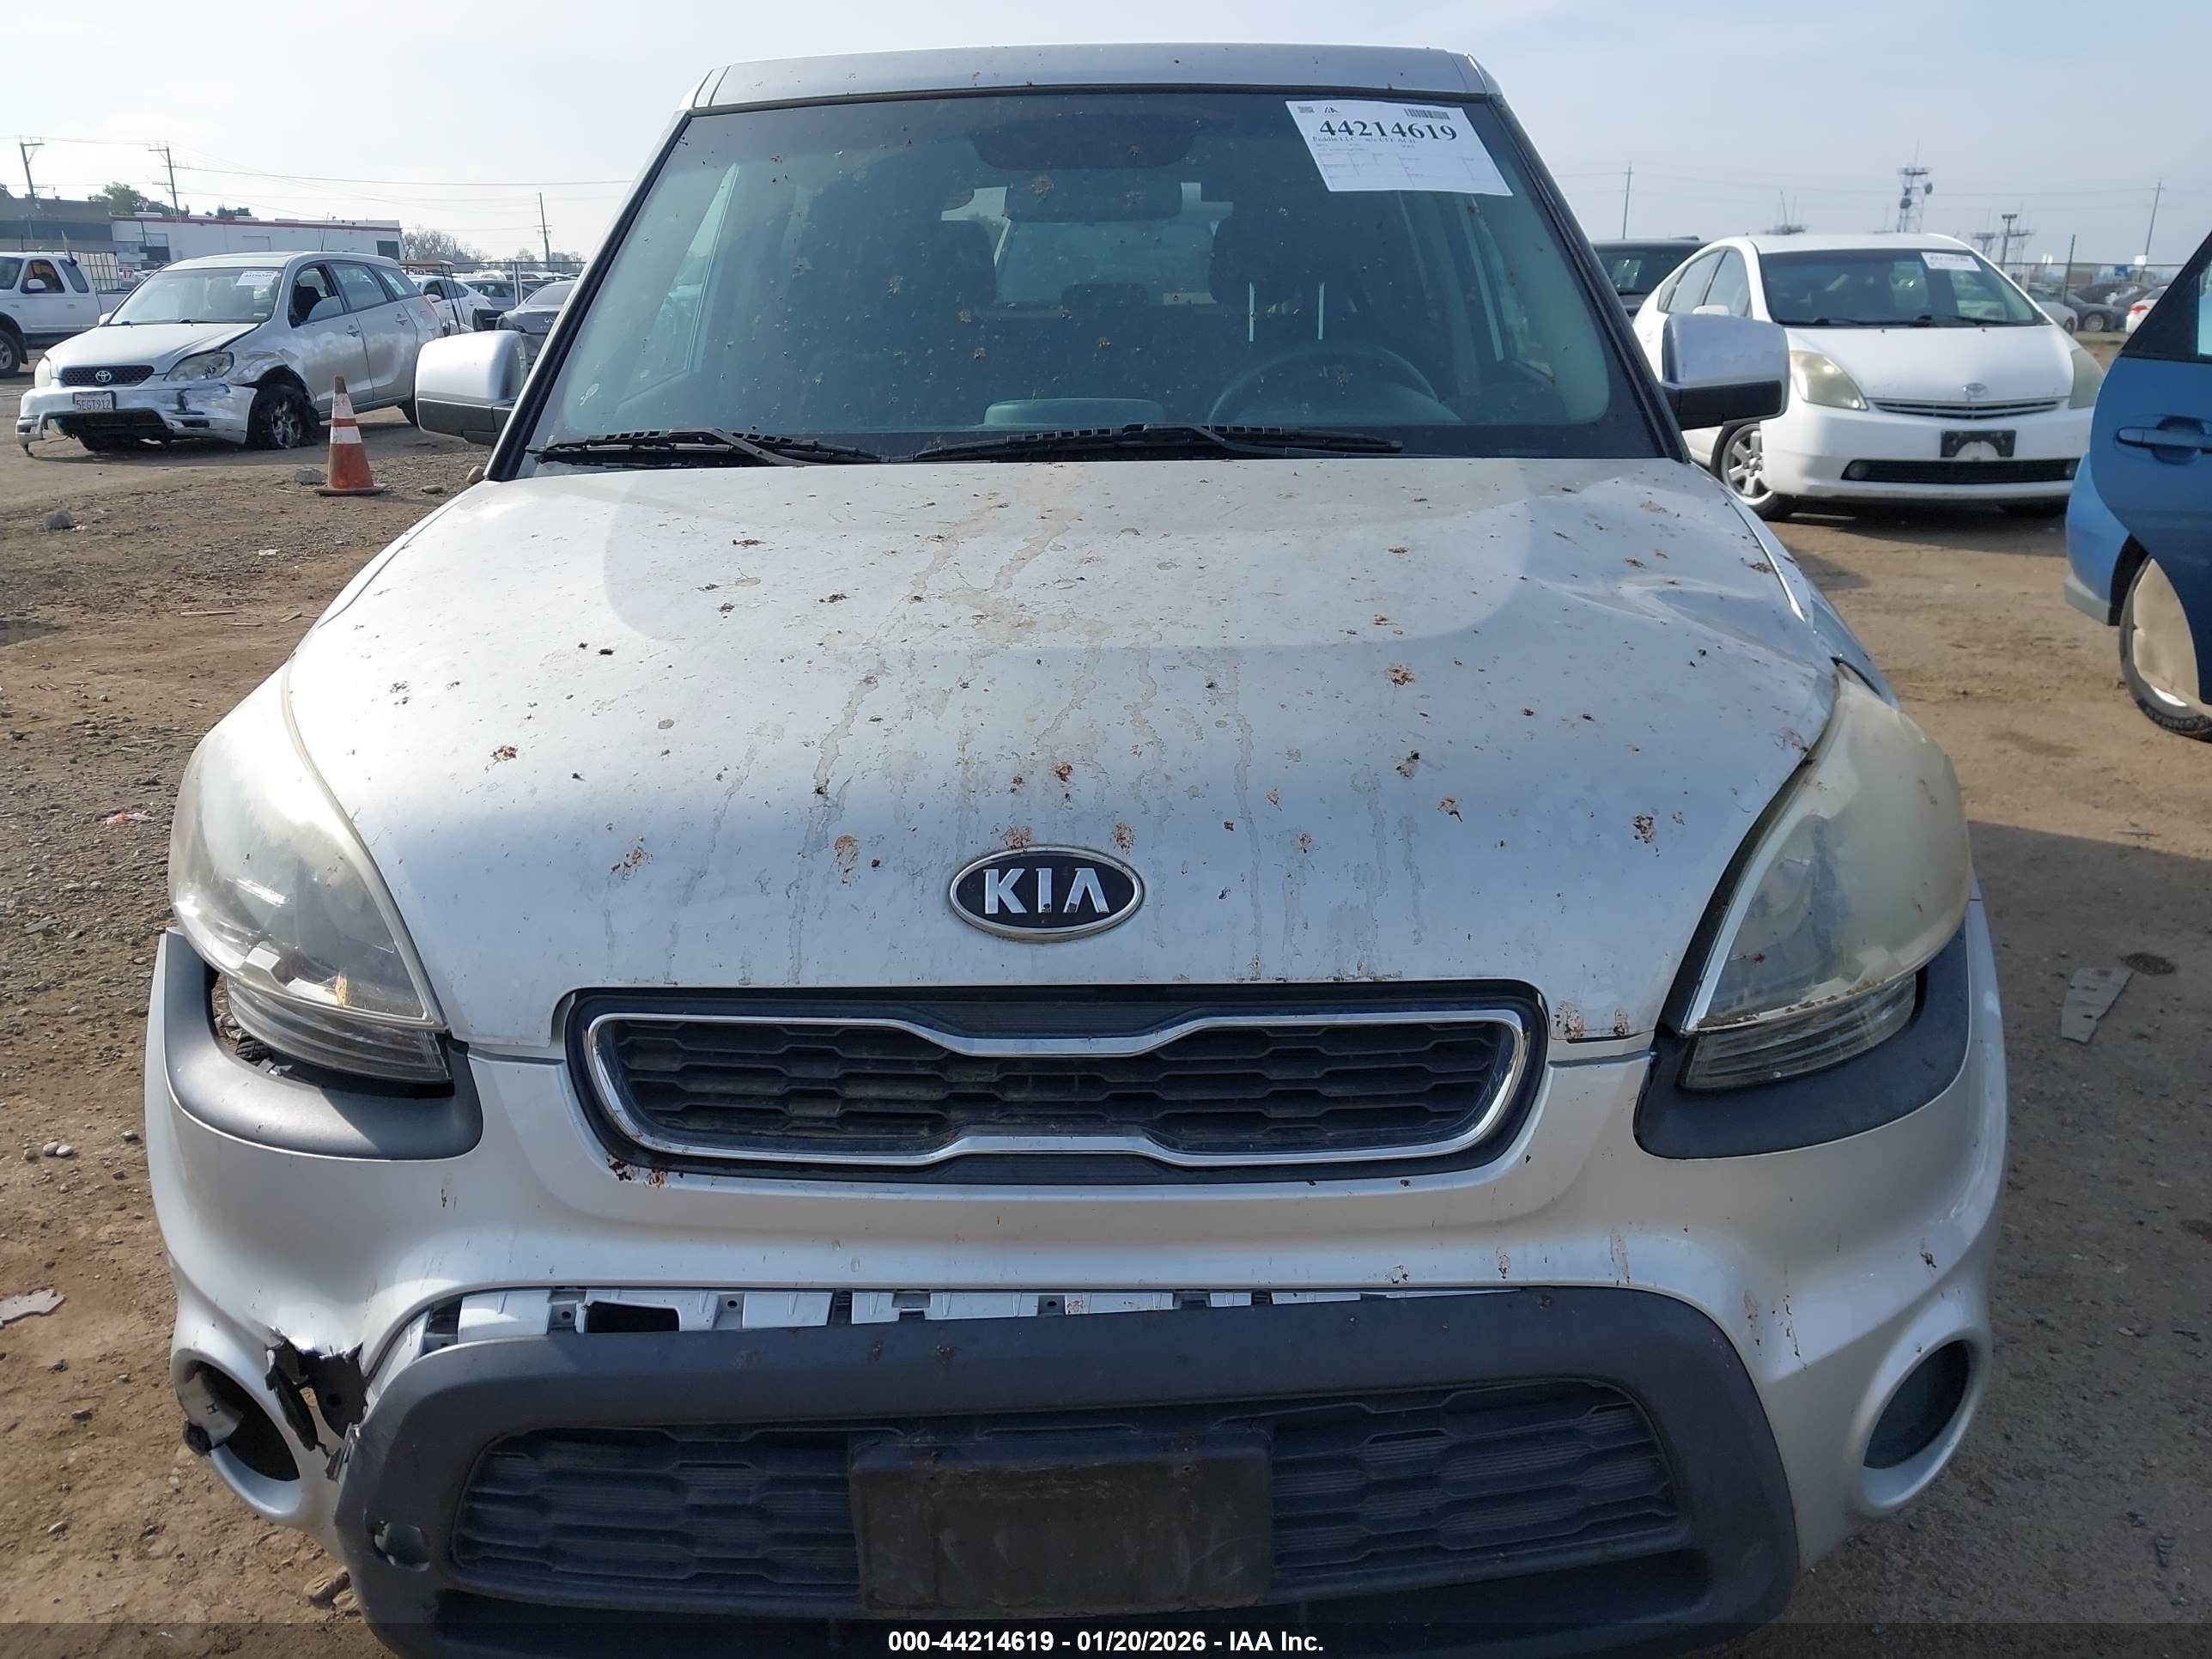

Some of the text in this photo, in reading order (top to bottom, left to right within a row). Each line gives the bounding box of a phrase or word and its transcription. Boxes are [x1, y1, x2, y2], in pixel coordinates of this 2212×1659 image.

[1320, 120, 1457, 141] 44214619
[76, 399, 111, 410] 5EGT912
[983, 867, 1110, 915] KIA
